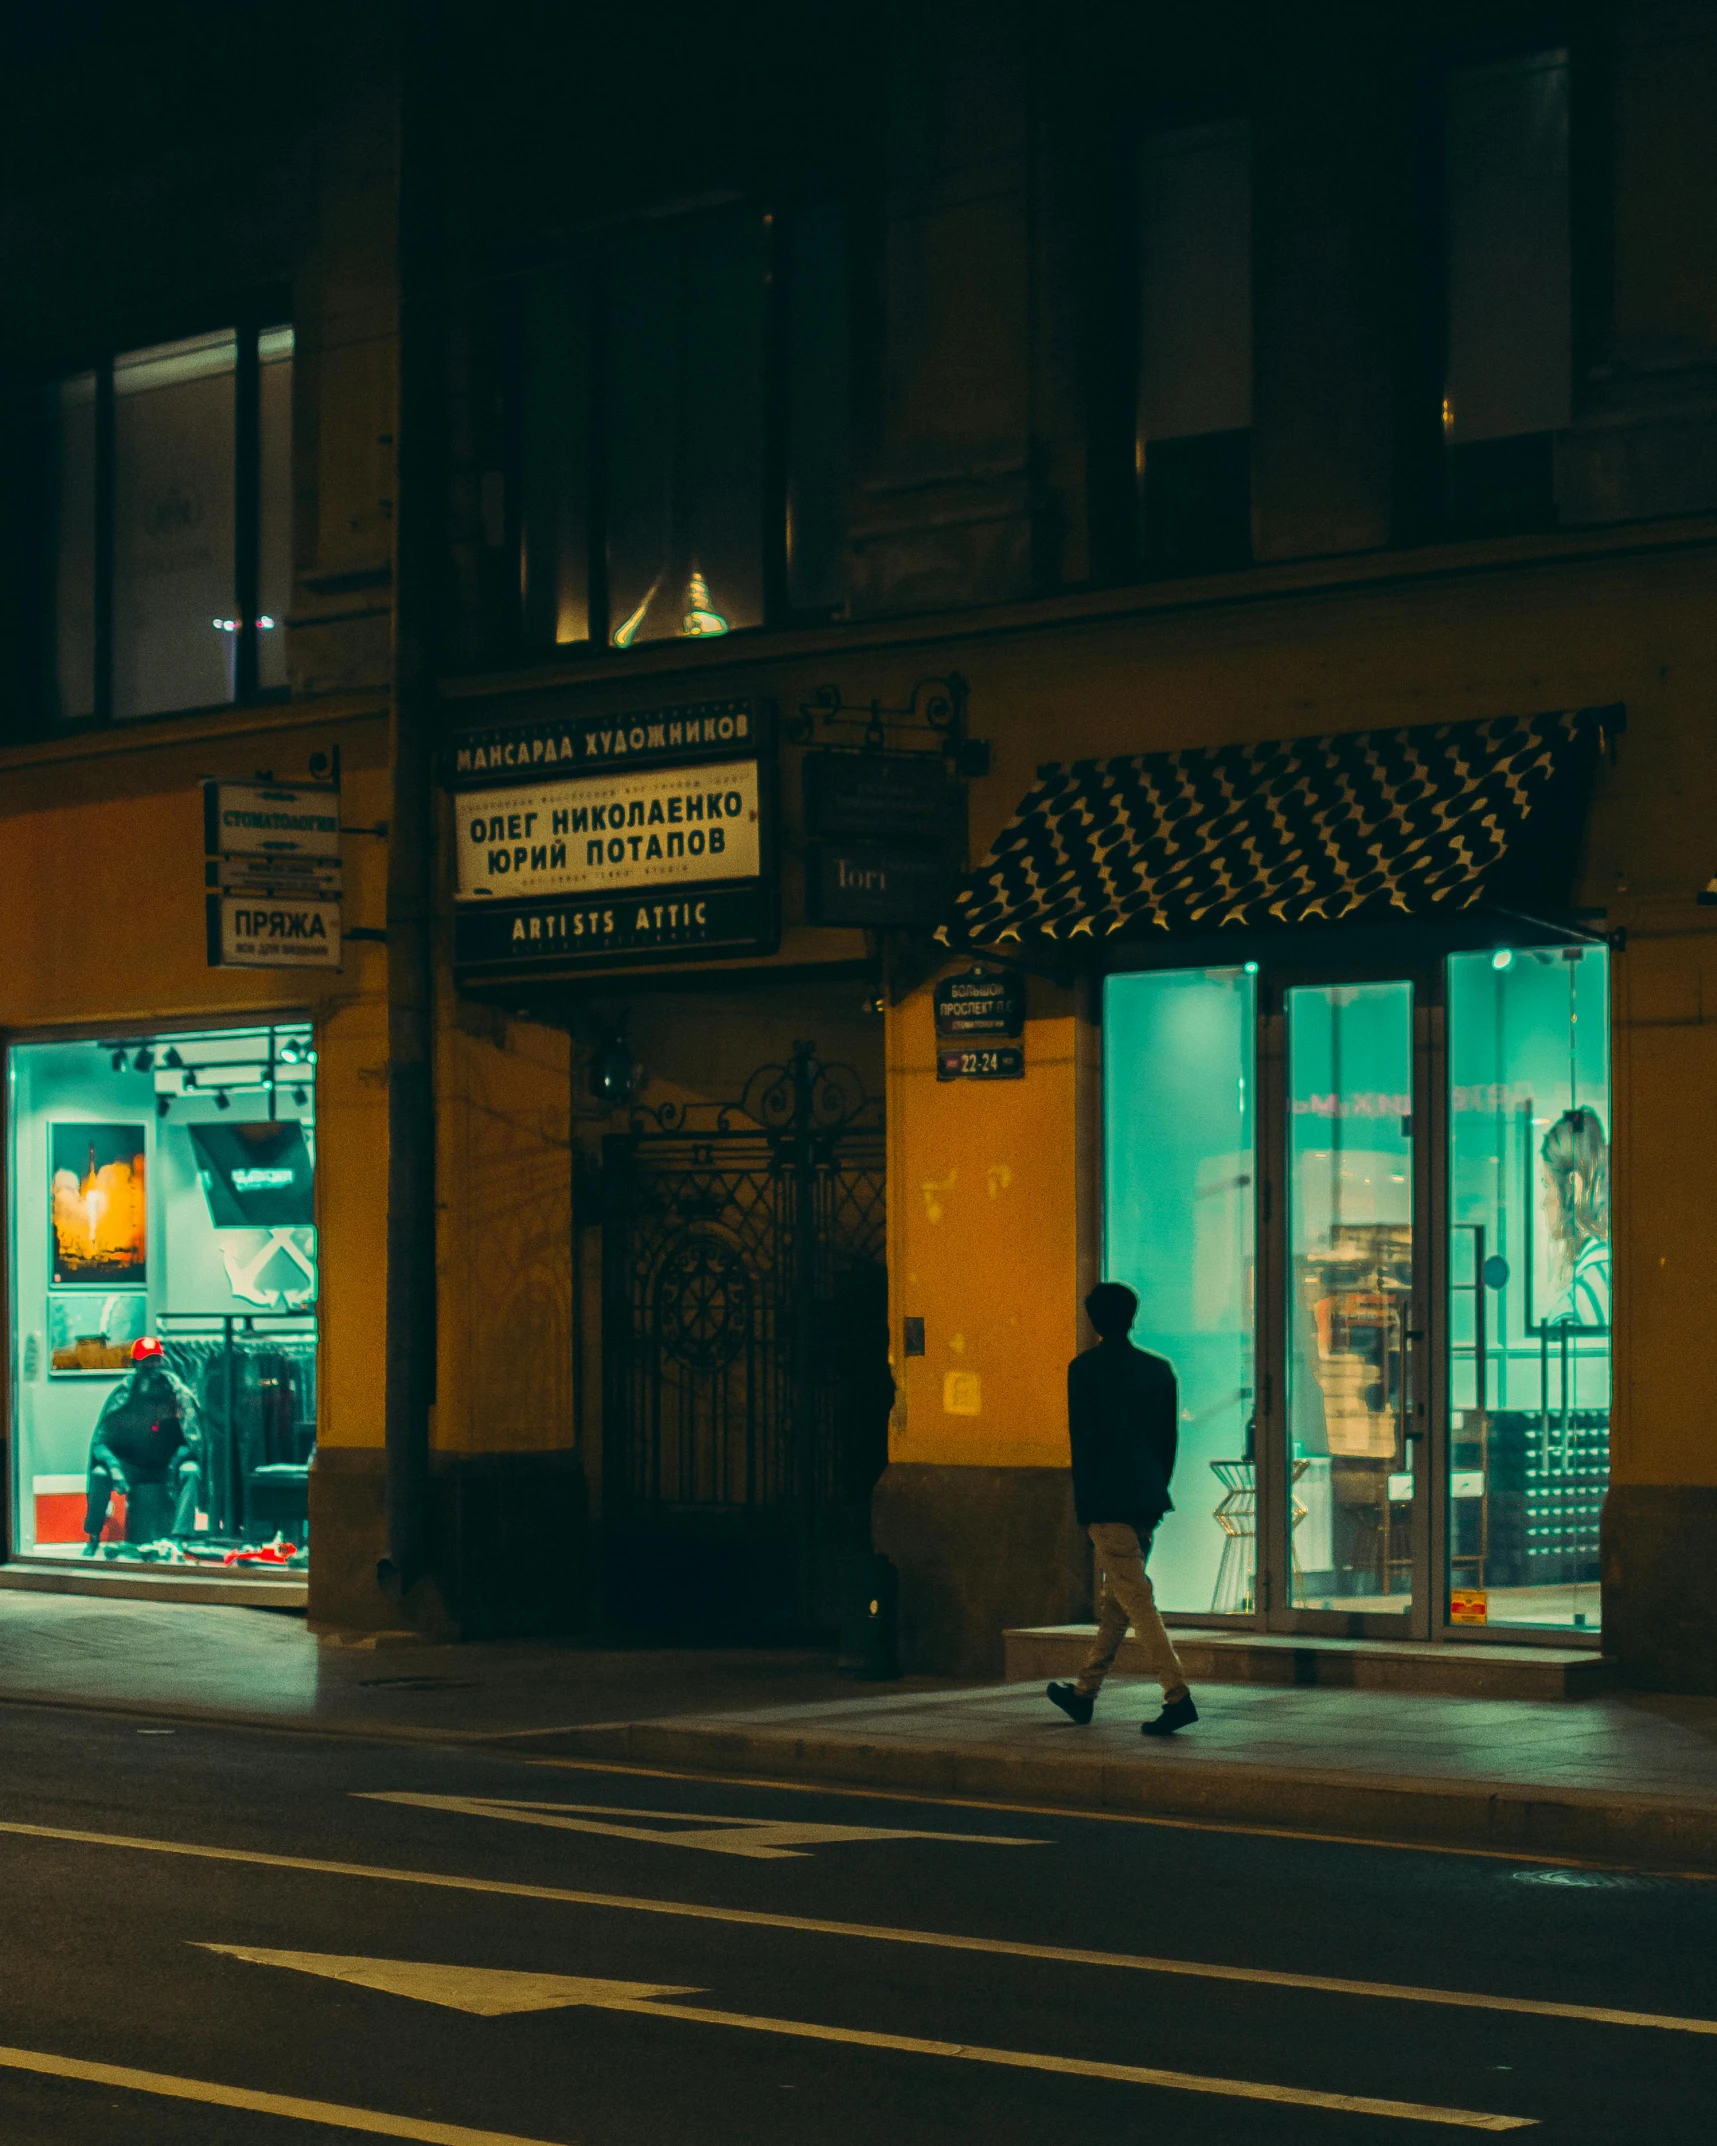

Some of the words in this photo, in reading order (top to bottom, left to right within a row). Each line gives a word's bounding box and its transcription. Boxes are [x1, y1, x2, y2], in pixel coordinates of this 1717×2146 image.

[457, 735, 574, 772] МАНСАРДА
[585, 714, 748, 756] ХУДОЖНИКОВ
[470, 813, 538, 844] ОЛЕГ
[552, 791, 742, 836] НИКОЛАЕНКО
[487, 839, 567, 874] ЮРИЙ
[586, 827, 726, 865] ПОТАПОВ
[832, 857, 887, 890] Tori
[235, 910, 327, 938] ПРЯЖА
[511, 910, 615, 941] ARTISTS
[635, 901, 707, 931] ATTIC
[940, 1001, 993, 1016] ПРОСПЕКТ
[960, 1052, 998, 1073] 22-24
